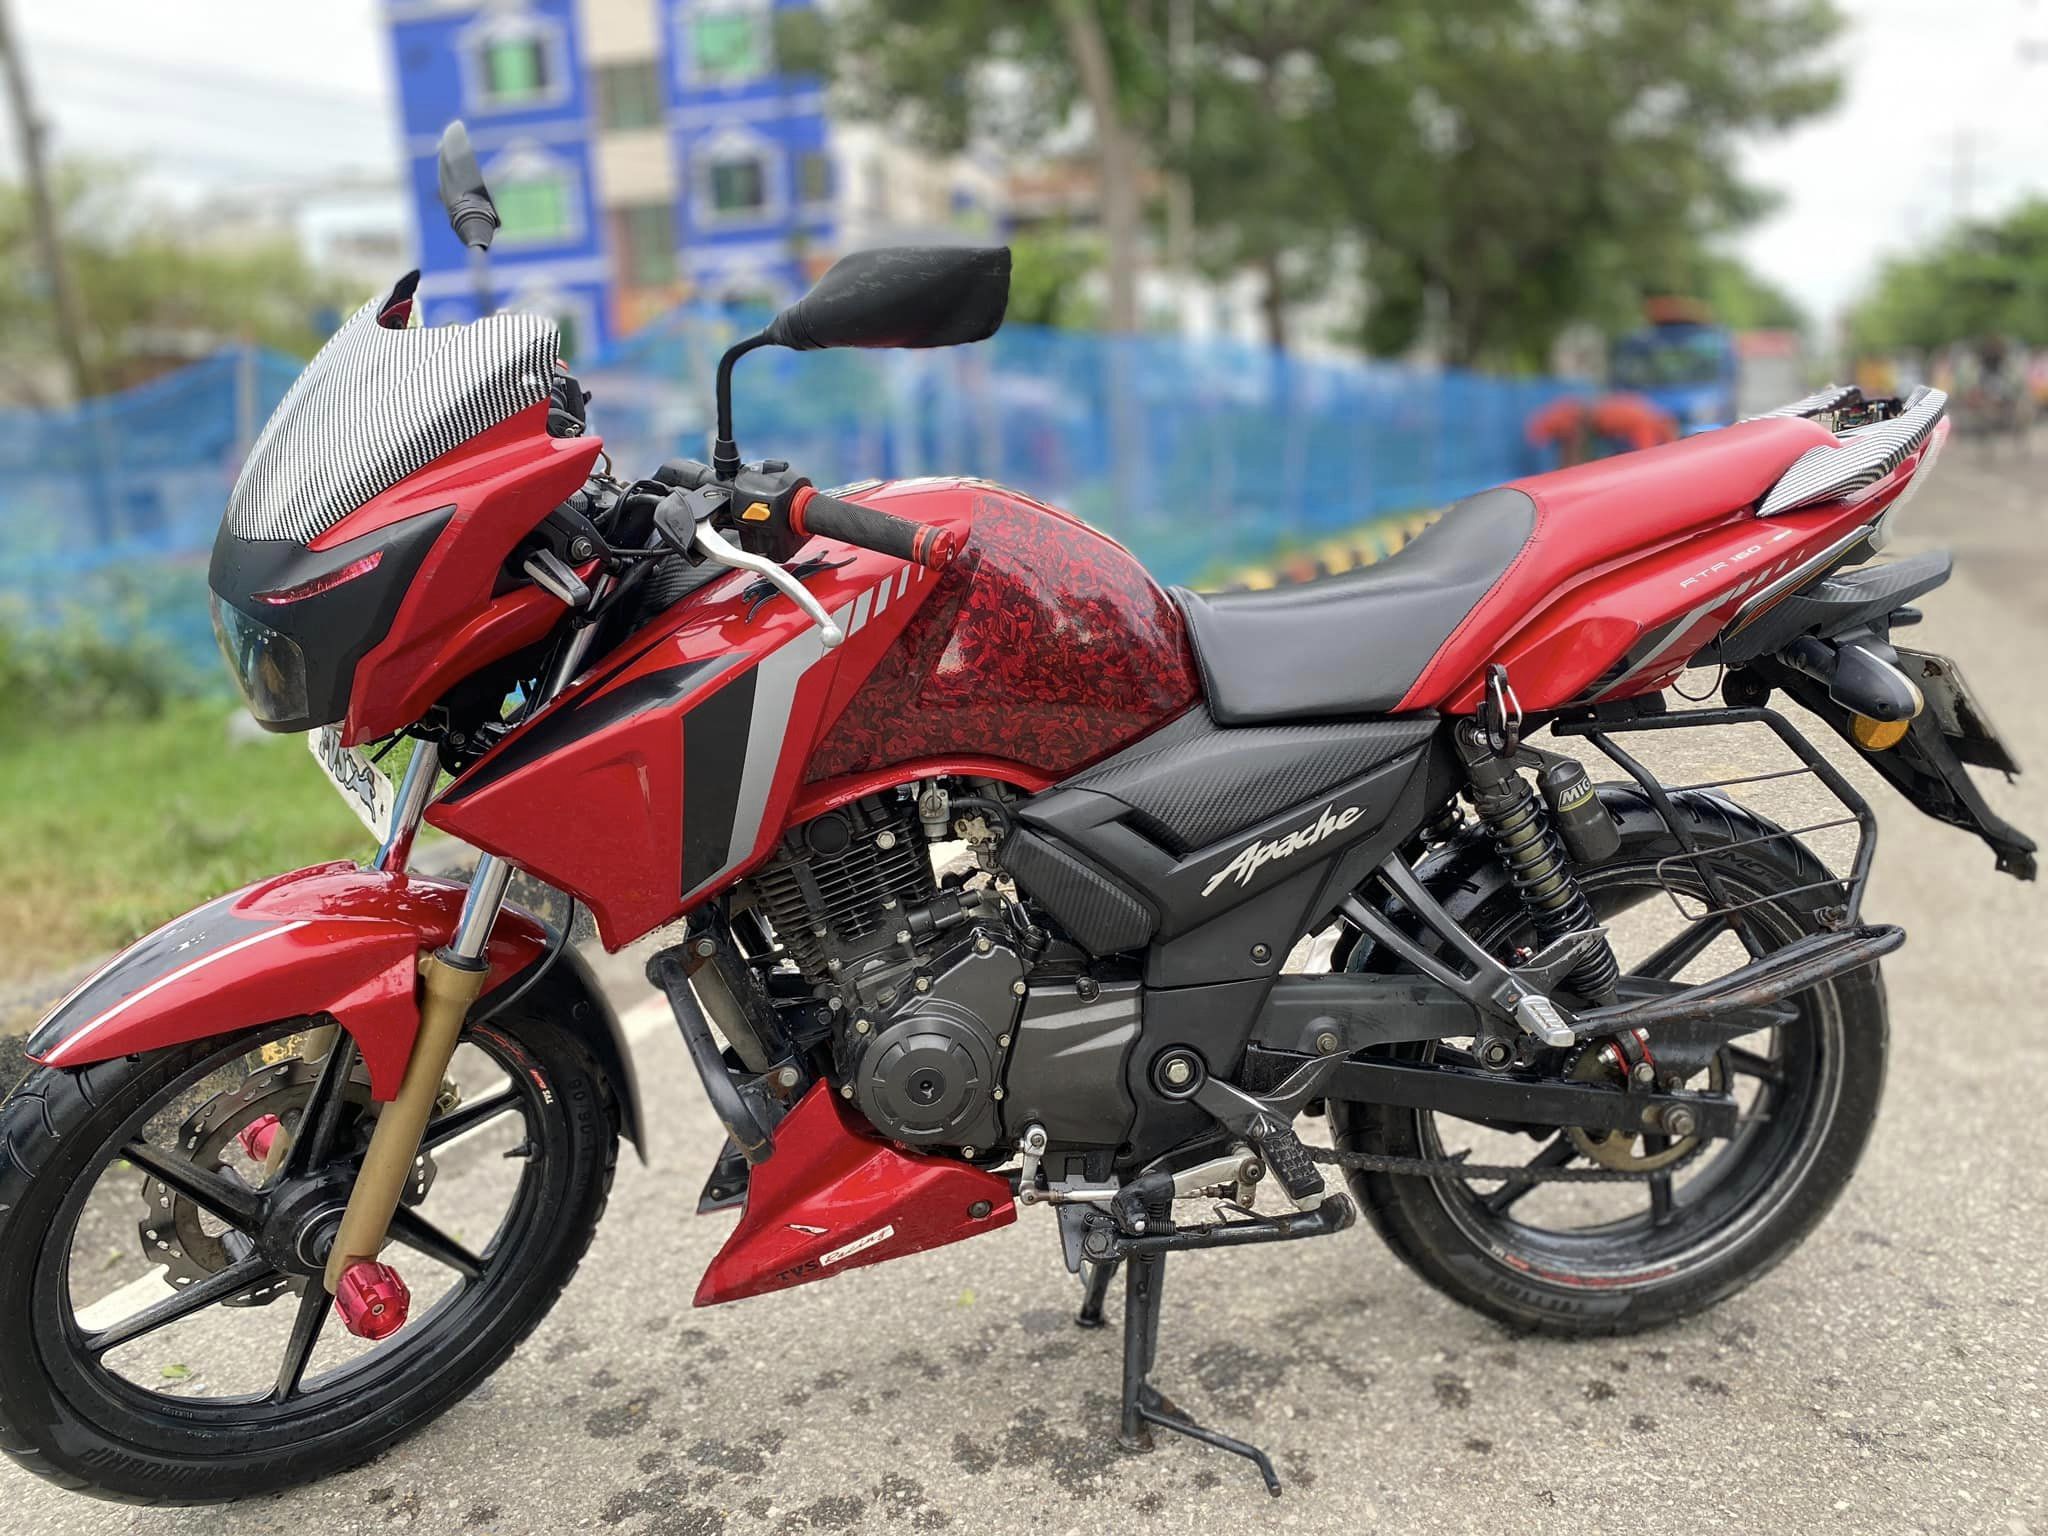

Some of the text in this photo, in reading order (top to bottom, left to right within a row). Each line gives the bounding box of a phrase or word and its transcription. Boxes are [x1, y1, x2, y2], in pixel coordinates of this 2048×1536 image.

[1680, 545, 1761, 589] RTR 160
[1562, 777, 1591, 805] MIG
[1201, 803, 1367, 897] Apache
[776, 1228, 888, 1282] TVS Racing
